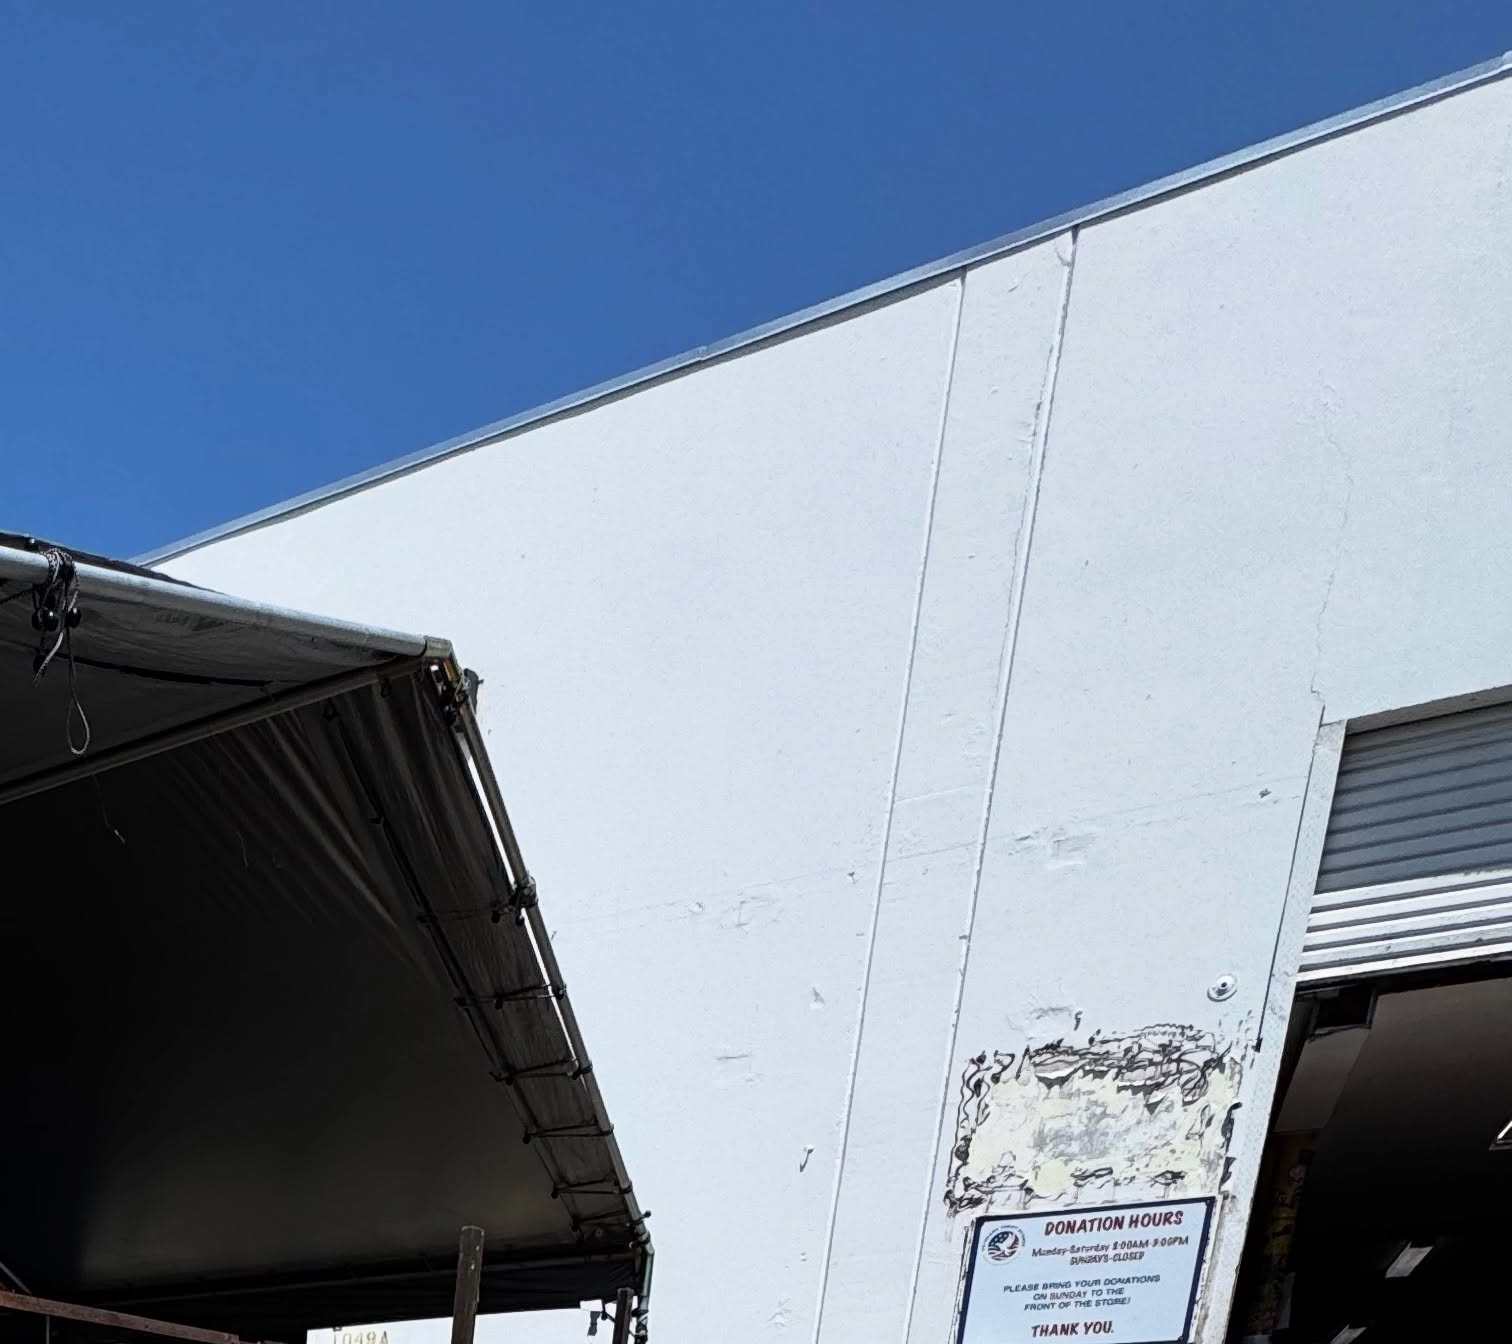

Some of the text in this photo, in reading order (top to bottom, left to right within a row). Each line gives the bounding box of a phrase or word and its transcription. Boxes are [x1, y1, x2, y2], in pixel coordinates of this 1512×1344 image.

[1044, 1210, 1184, 1236] DONATION HOURS
[1003, 1274, 1161, 1293] PLEASE BRING YOUR DONATIONS
[1033, 1287, 1125, 1301] ON SUNDAY TO THE
[1024, 1301, 1055, 1311] FRONT
[1058, 1300, 1071, 1310] OF
[1074, 1299, 1092, 1308] THE
[1031, 1323, 1079, 1338] THANK
